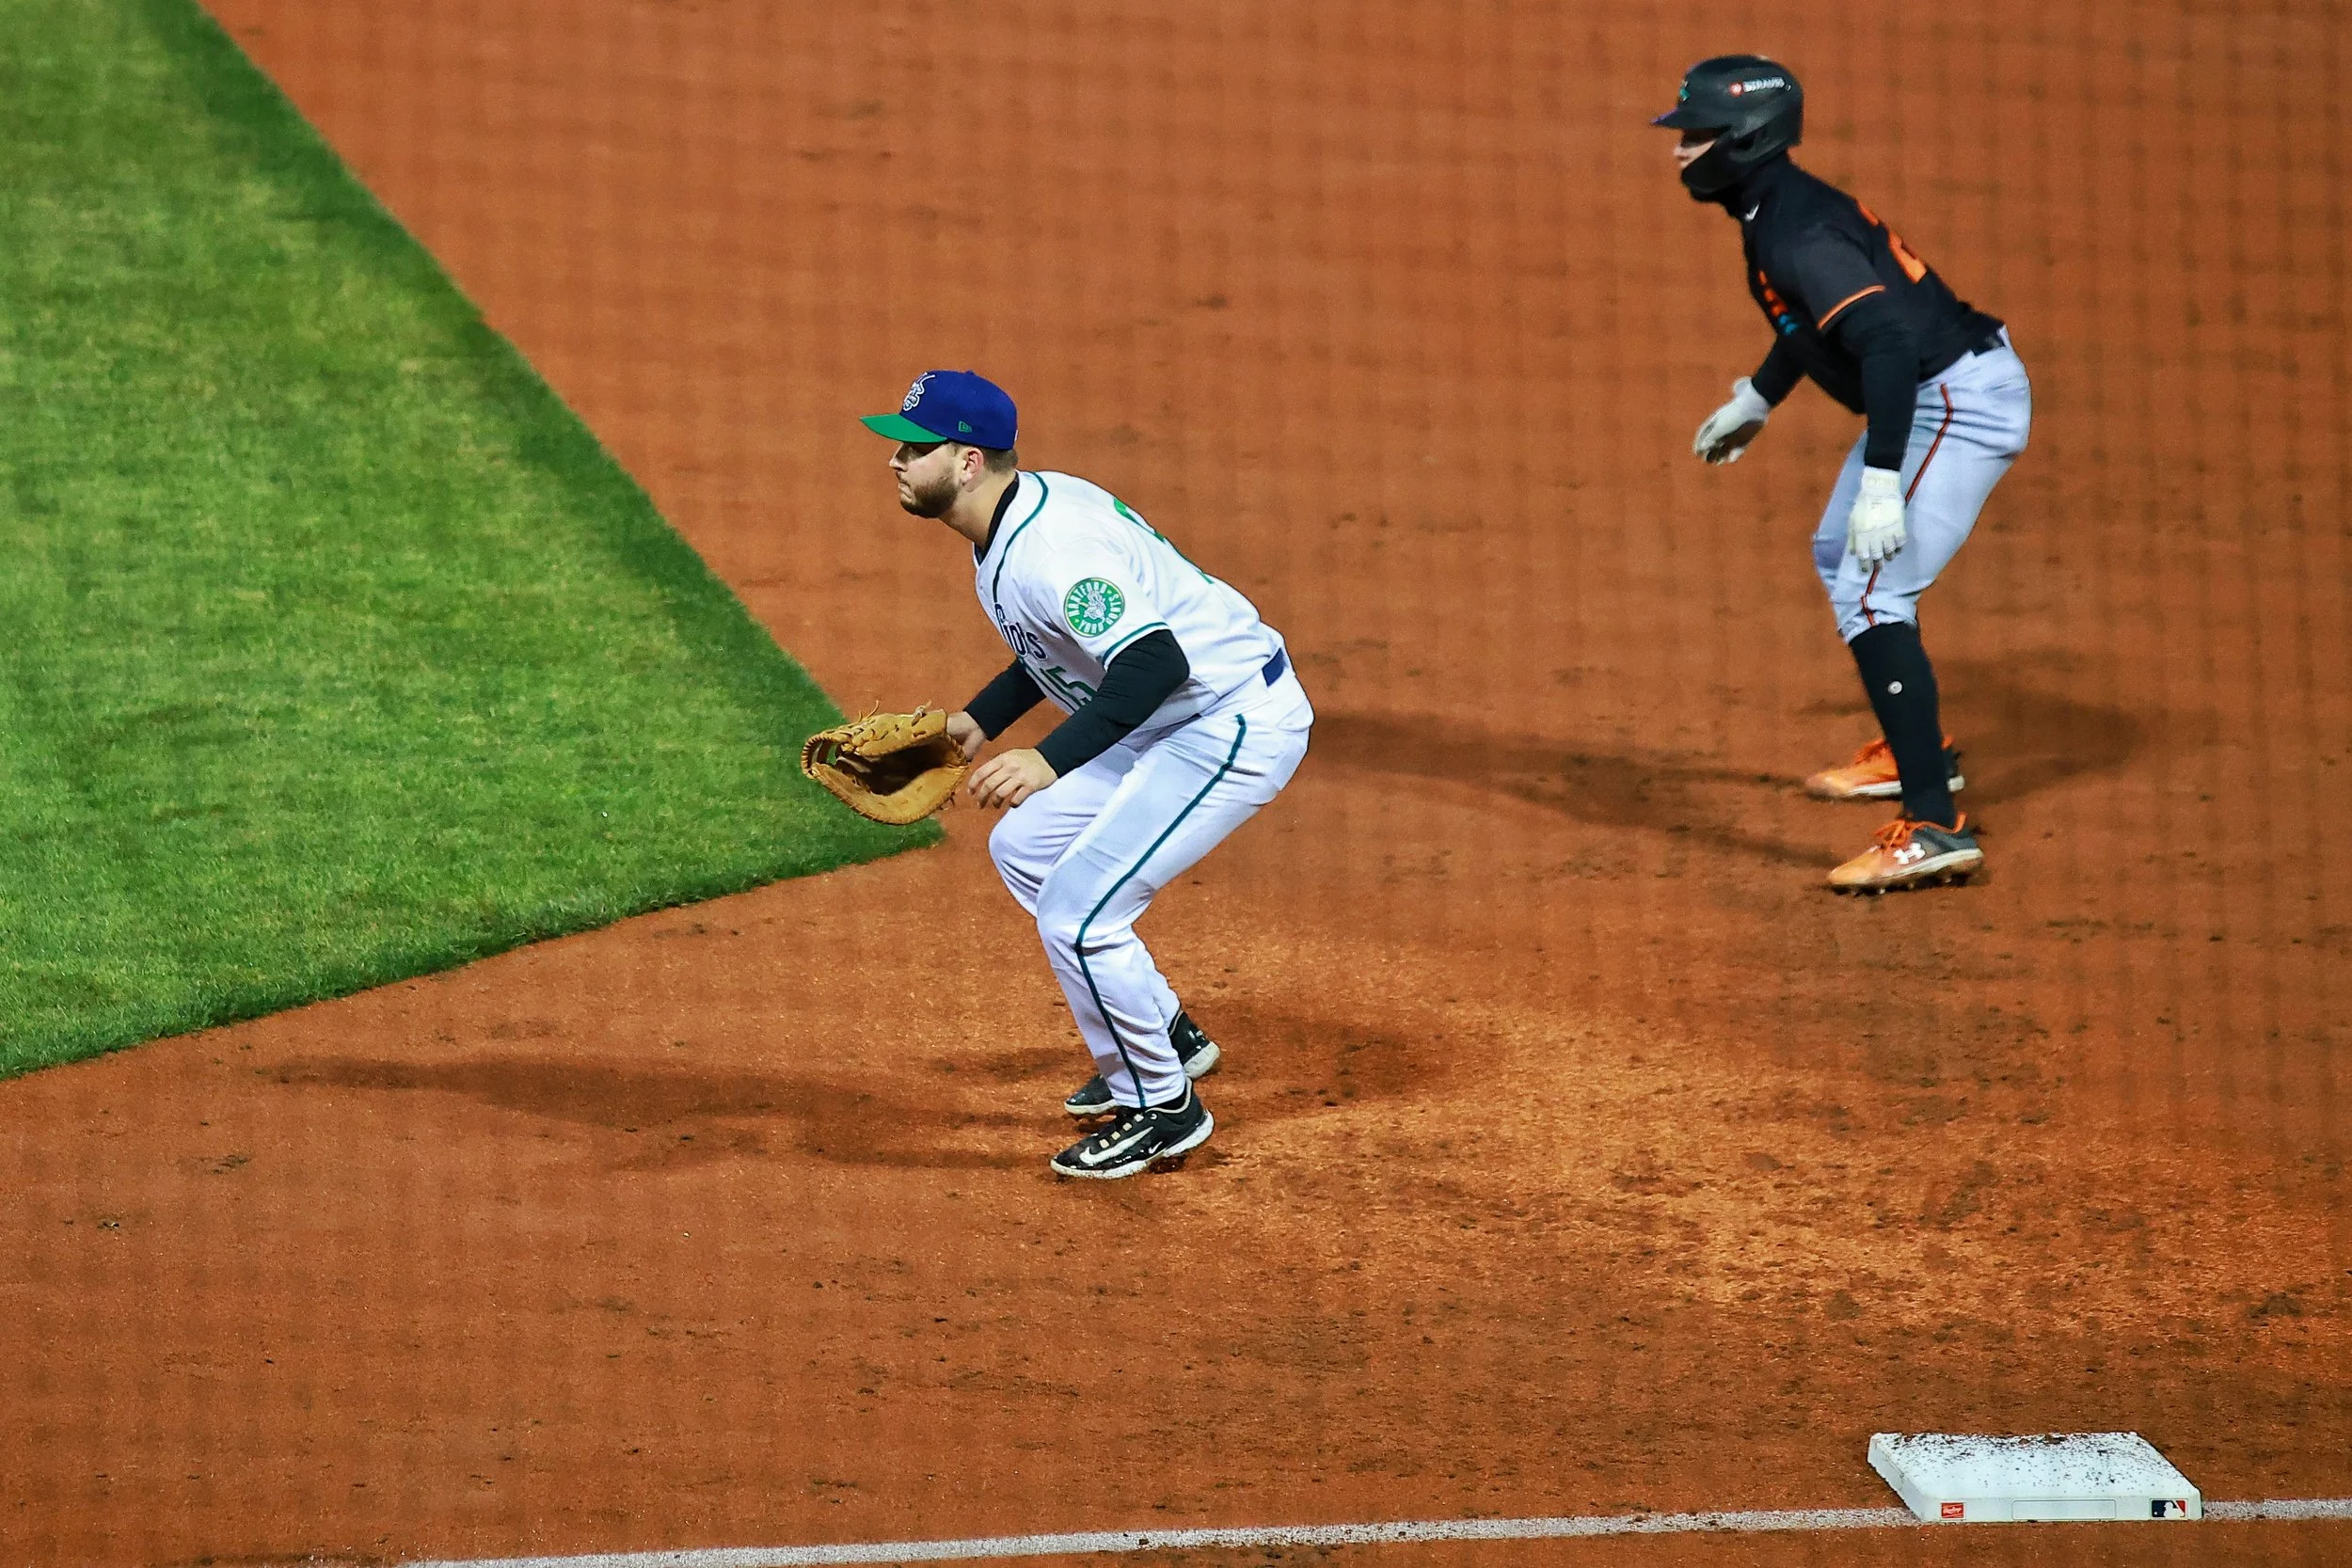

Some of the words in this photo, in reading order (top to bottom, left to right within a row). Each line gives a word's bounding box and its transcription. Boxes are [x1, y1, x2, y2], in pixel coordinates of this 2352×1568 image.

[1068, 581, 1108, 617] HARTFORD
[1077, 619, 1104, 634] YARD
[1105, 594, 1121, 626] GOATS
